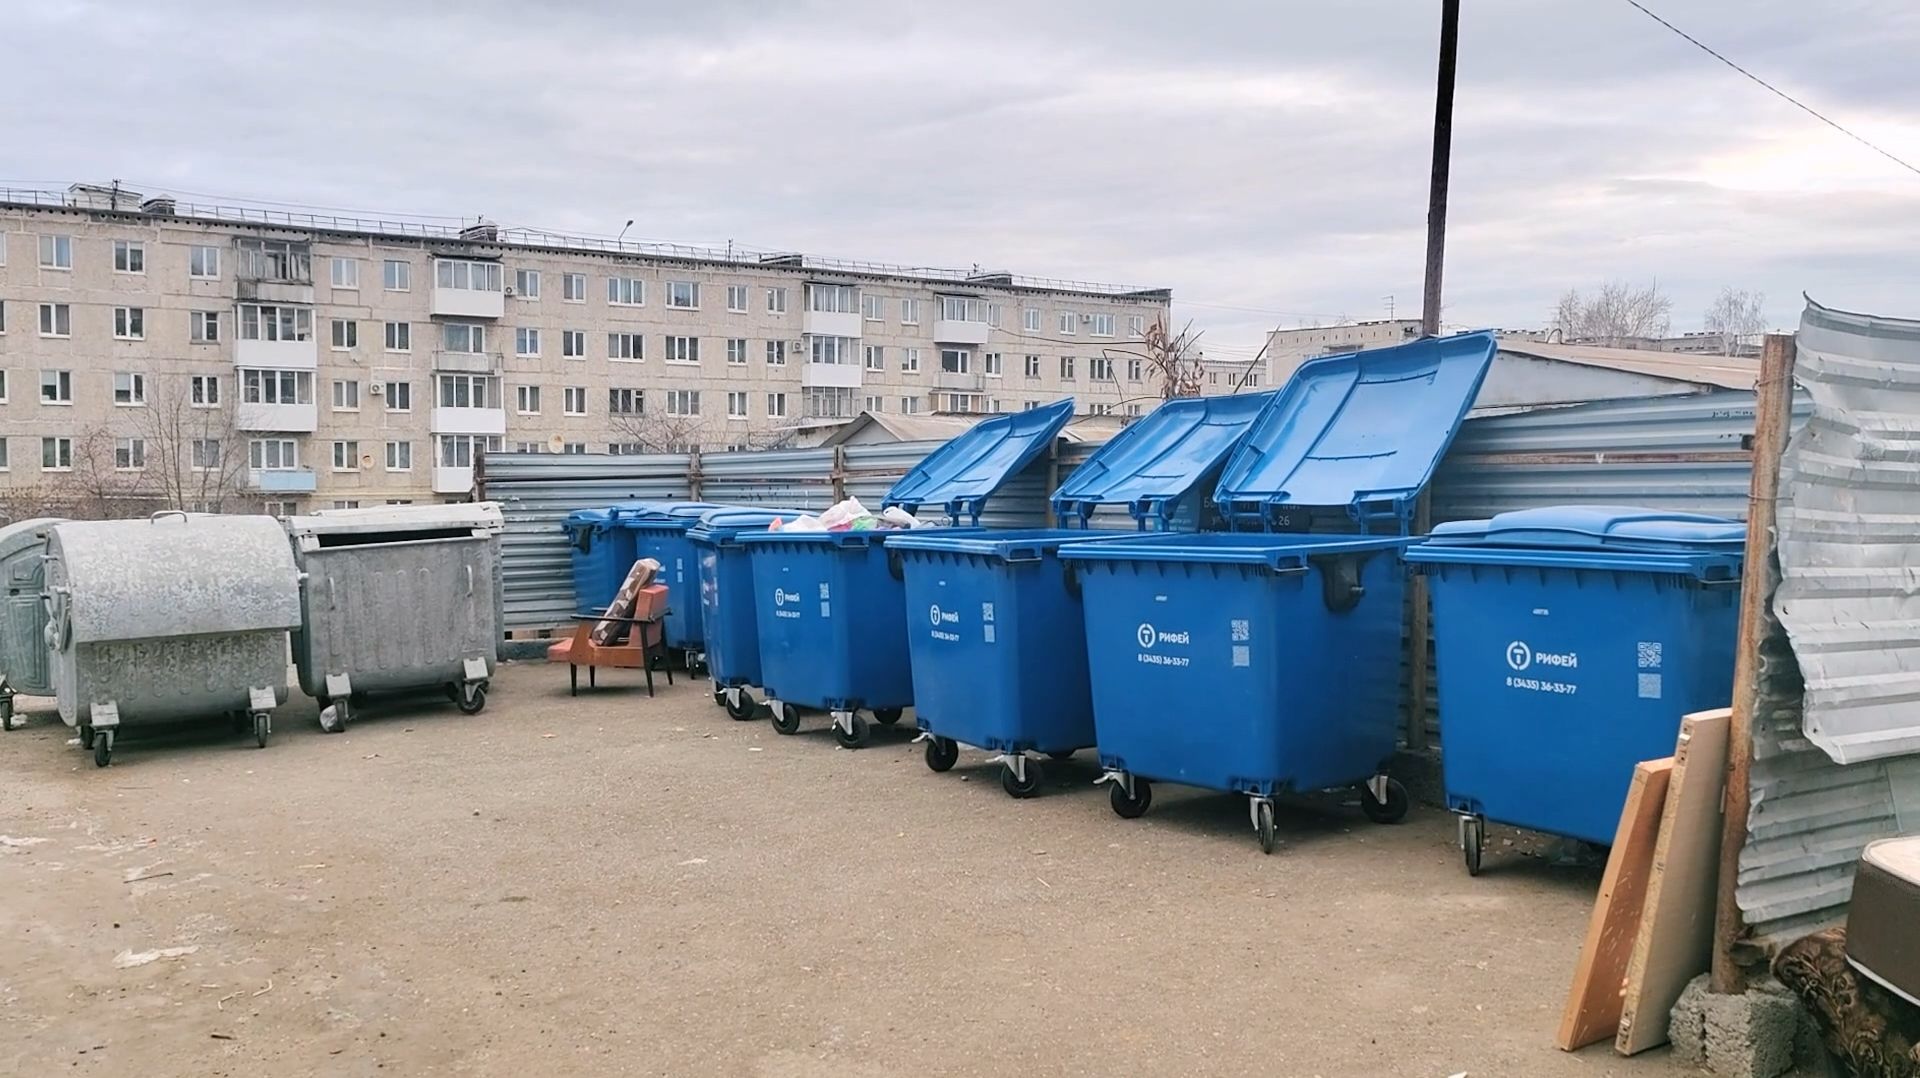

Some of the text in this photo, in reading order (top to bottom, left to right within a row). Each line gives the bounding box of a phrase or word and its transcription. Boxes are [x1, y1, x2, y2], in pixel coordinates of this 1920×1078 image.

[1278, 515, 1290, 526] 26
[1158, 631, 1190, 645] РИФЕЙ
[1535, 652, 1578, 668] РИФЕЙ
[1506, 676, 1577, 695] 8 (3435) 36-33-77
